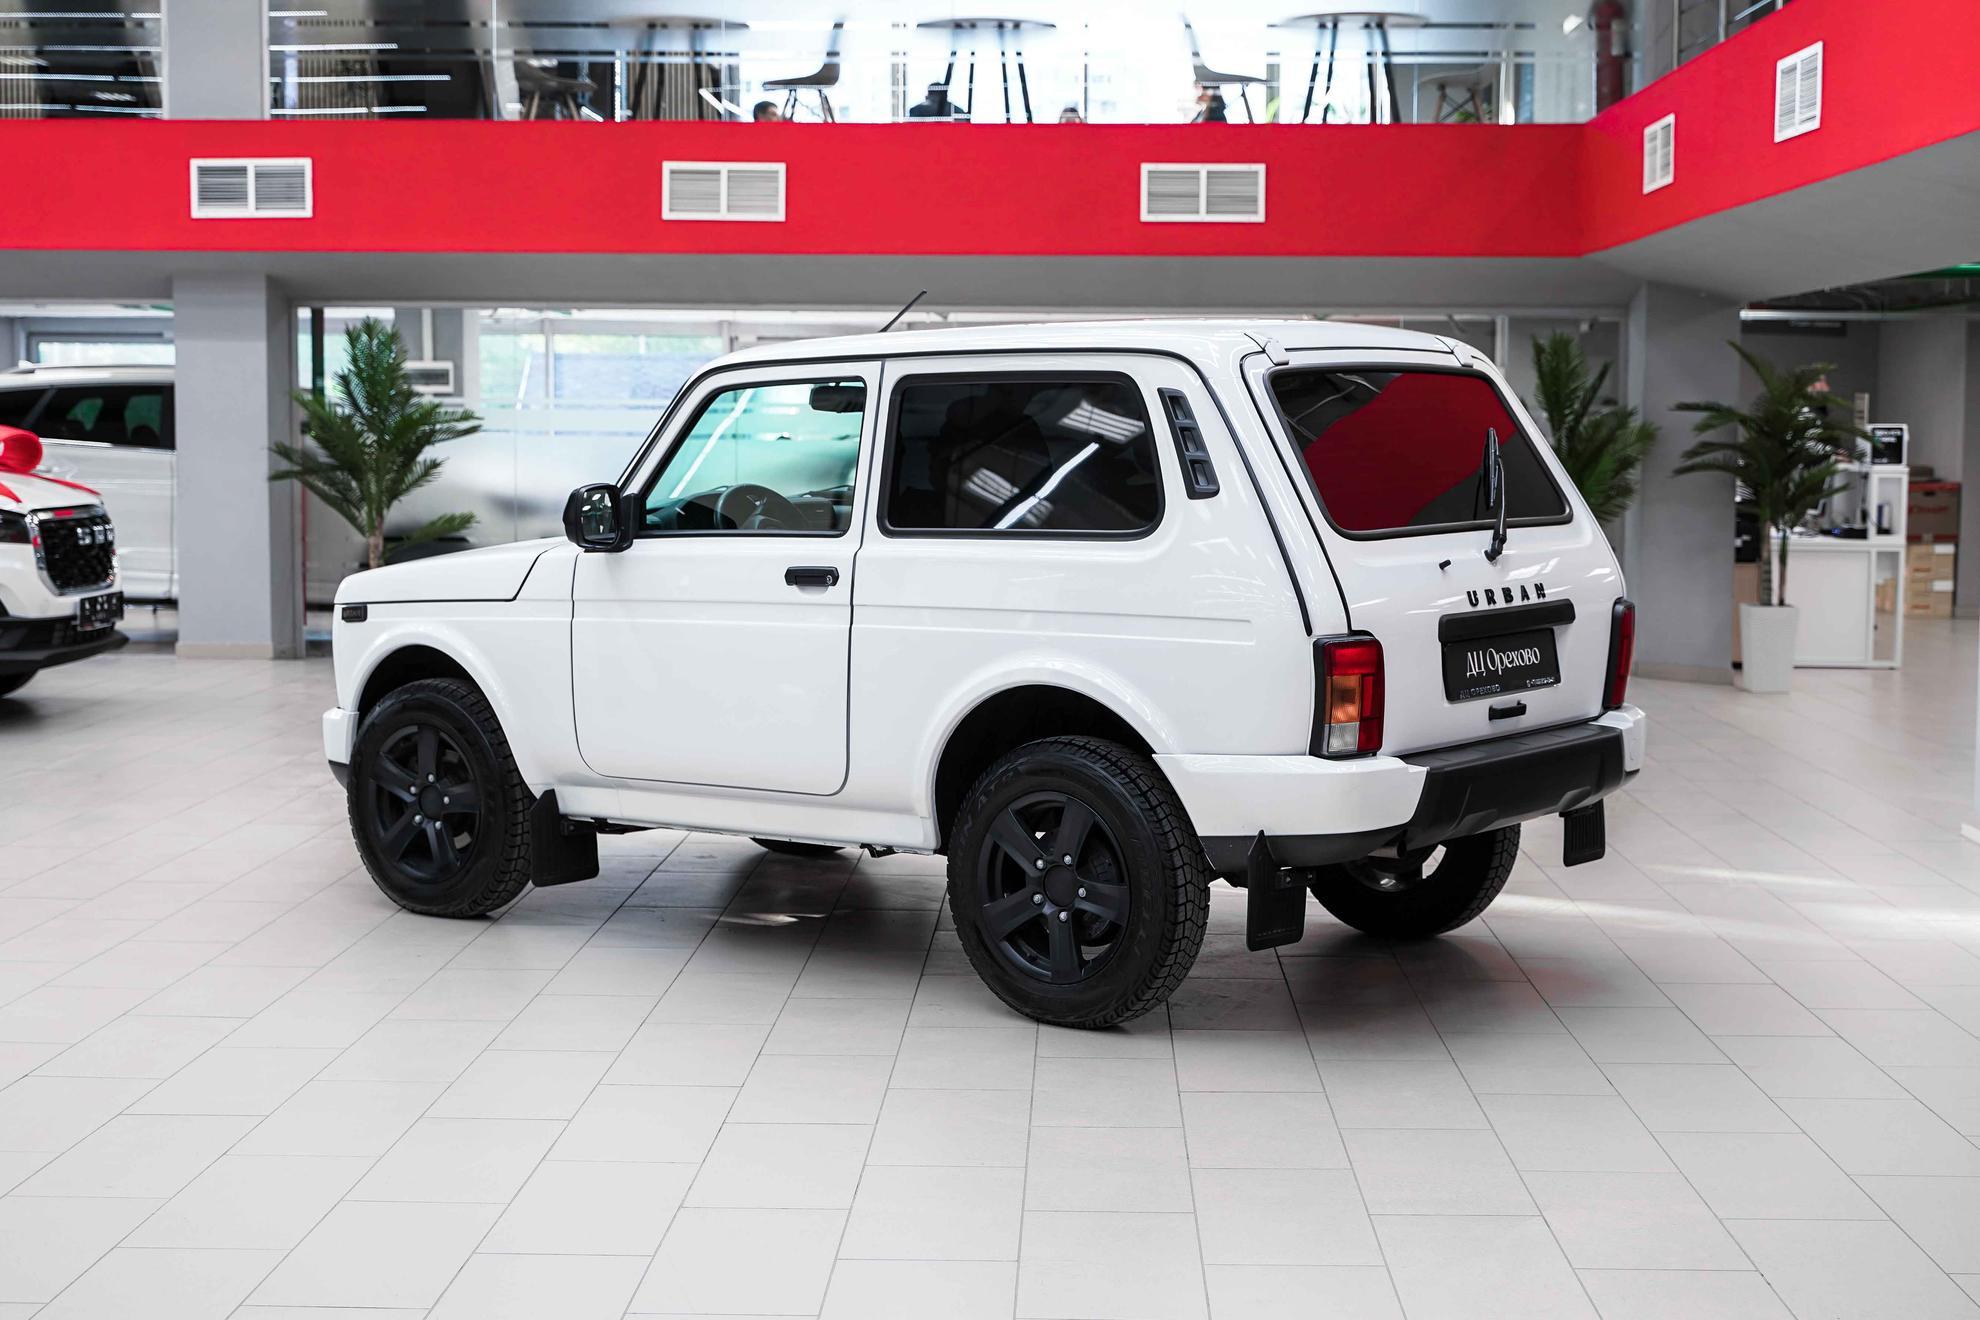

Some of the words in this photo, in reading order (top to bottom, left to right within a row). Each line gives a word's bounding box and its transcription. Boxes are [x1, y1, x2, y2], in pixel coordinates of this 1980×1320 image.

[1466, 583, 1546, 607] URBAN
[1466, 650, 1486, 679] ДЦ
[1486, 647, 1541, 676] Орехово
